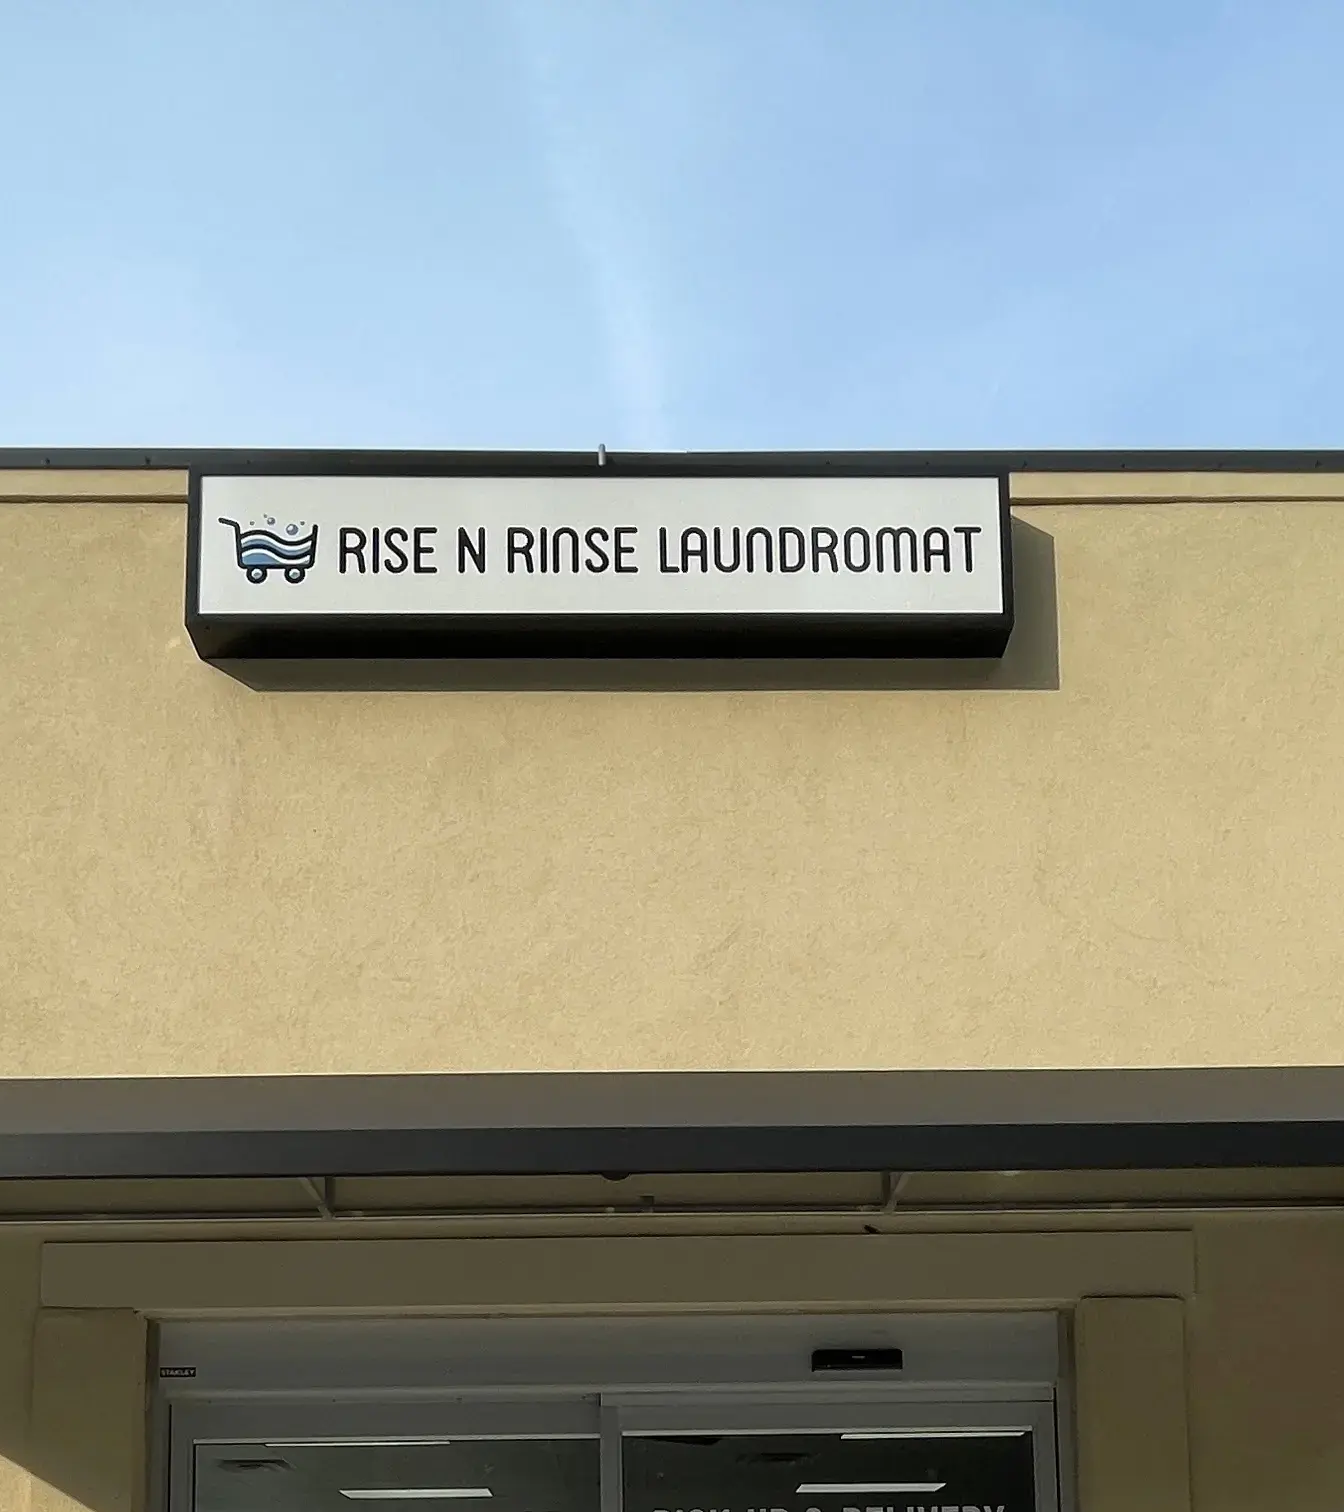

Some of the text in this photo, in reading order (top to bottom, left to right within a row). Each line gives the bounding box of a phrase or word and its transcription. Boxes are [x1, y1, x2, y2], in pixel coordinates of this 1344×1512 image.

[338, 526, 982, 575] RISE N RINSE LAUNDROMAT
